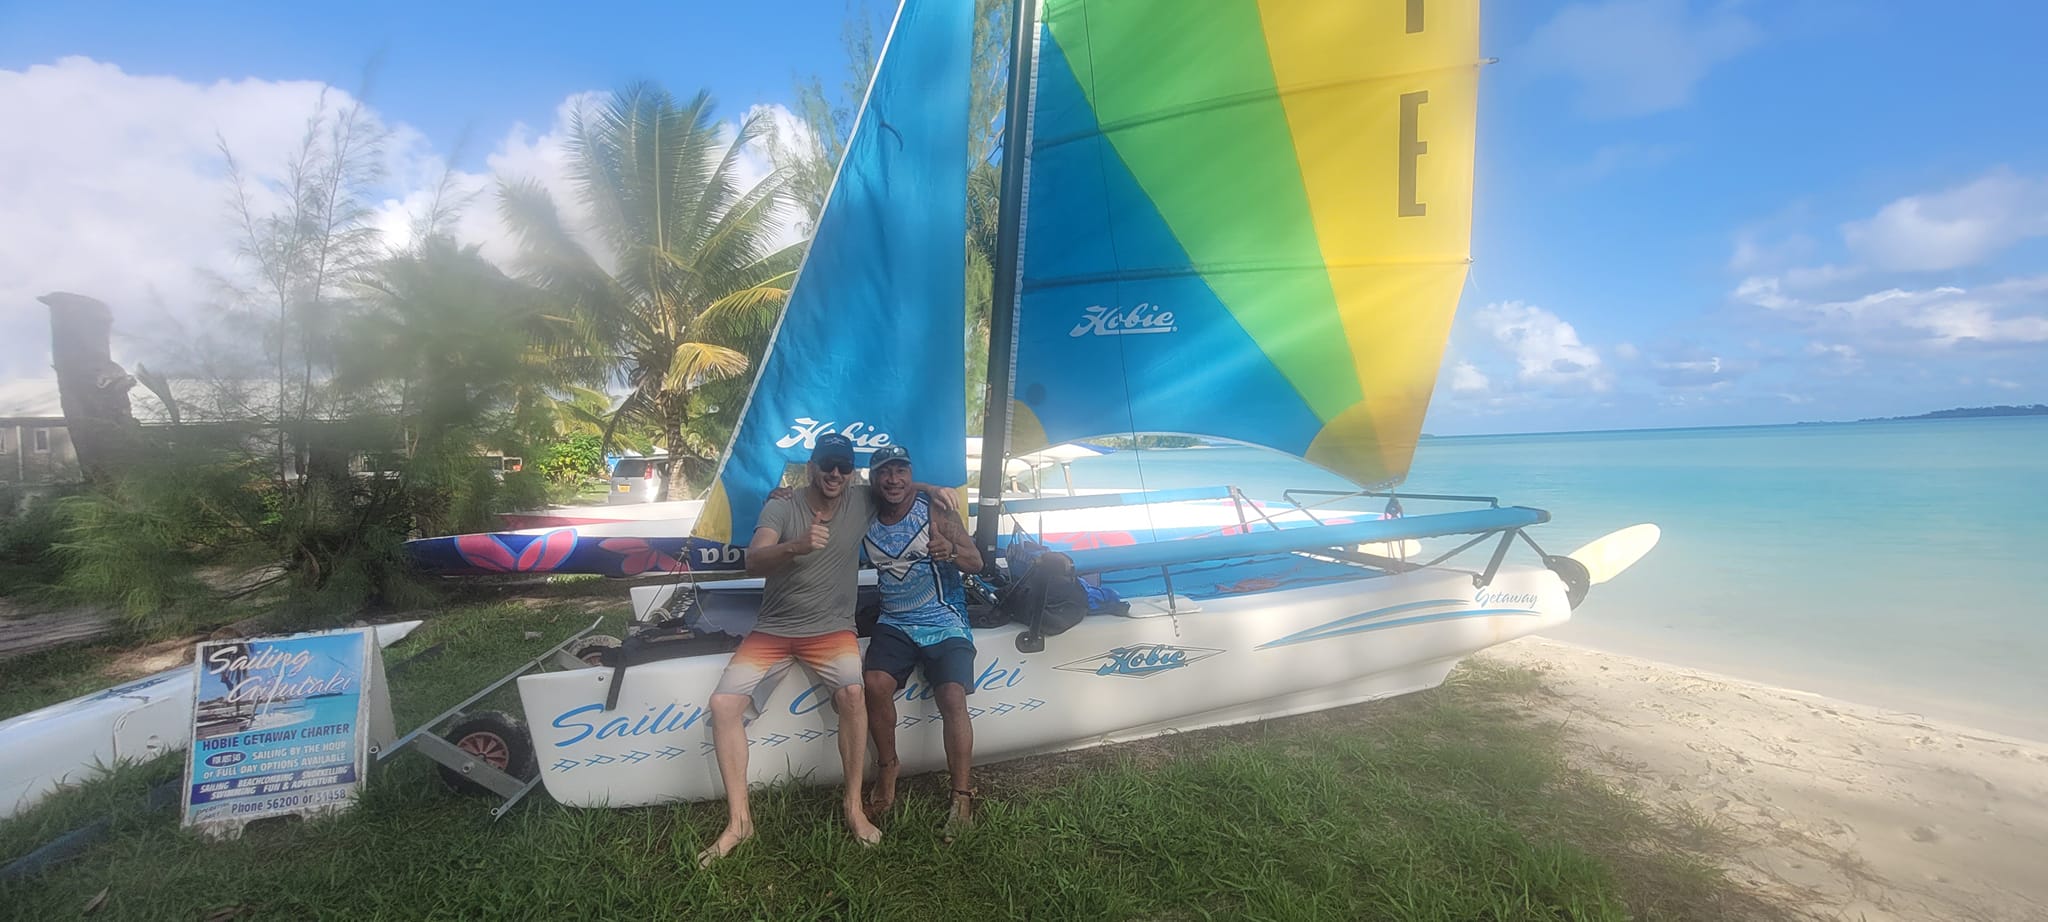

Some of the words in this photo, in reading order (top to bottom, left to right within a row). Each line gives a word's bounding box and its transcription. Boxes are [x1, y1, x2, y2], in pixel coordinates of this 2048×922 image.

[1398, 0, 1428, 217] E
[1069, 303, 1175, 337] Hobie
[776, 417, 891, 453] Hbie
[1474, 588, 1538, 609] Getaway
[209, 645, 314, 677] Sailing
[1096, 644, 1185, 676] Hobie
[202, 736, 239, 751] HOBIE
[243, 729, 297, 746] GETAWAY
[300, 723, 350, 738] CHARTER
[252, 747, 287, 760] SAILING
[289, 746, 301, 756] BY
[303, 743, 320, 753] THE
[322, 741, 346, 751] HOUR
[203, 771, 214, 779] or
[216, 767, 237, 777] FULL
[240, 764, 258, 774] DAY
[260, 759, 299, 771] OPTIONS
[301, 753, 346, 766] AVAILABLE
[200, 781, 230, 793] SAILING
[237, 773, 294, 788] BEACHCOMBING
[210, 786, 257, 800] SWIMMING
[263, 783, 281, 793] FUN
[282, 782, 289, 790] &
[291, 776, 338, 789] ADVENTURE
[232, 802, 263, 814] Phone
[266, 796, 299, 809] 56200
[302, 795, 313, 804] or
